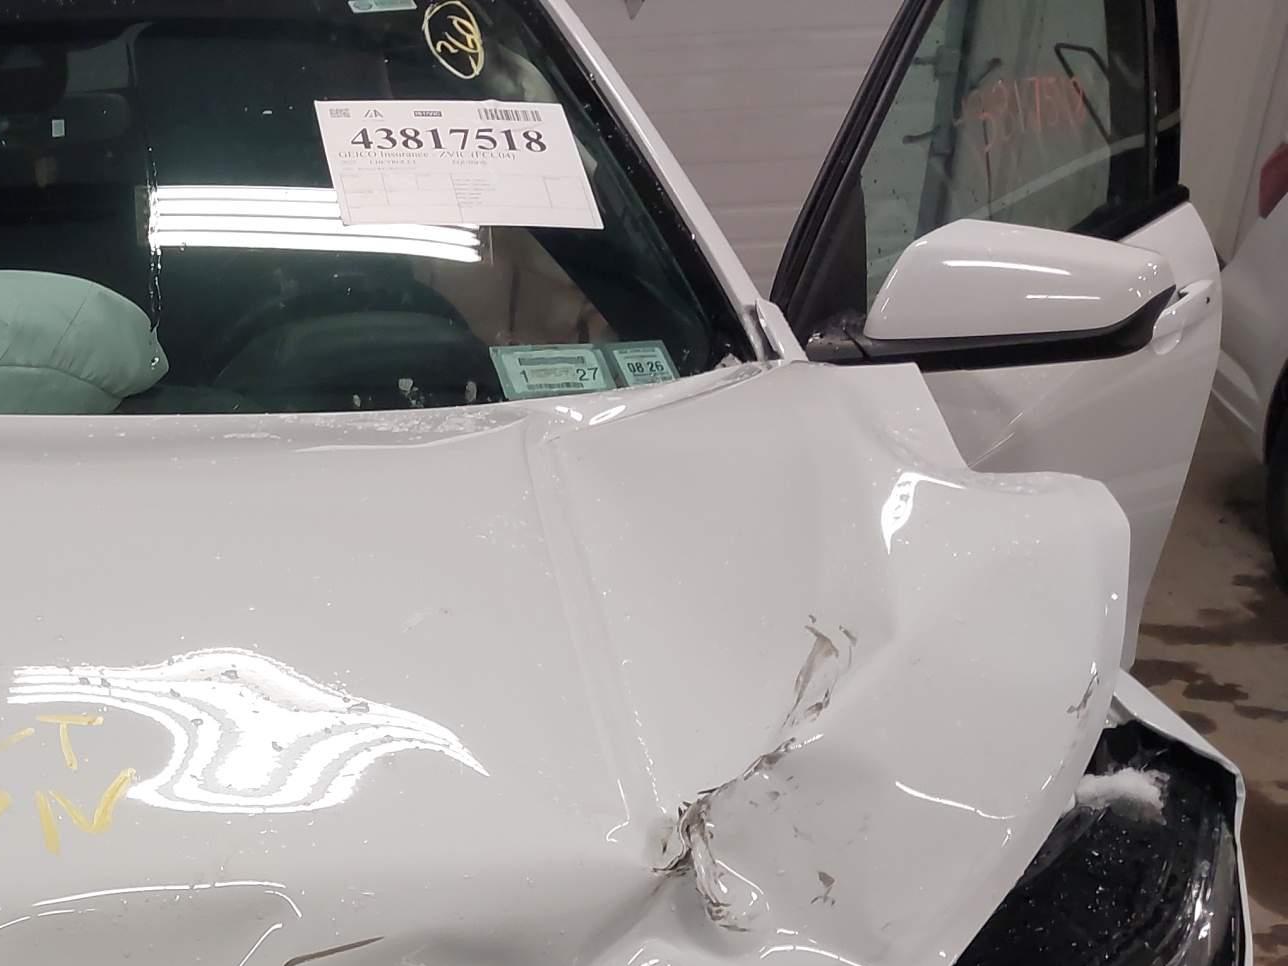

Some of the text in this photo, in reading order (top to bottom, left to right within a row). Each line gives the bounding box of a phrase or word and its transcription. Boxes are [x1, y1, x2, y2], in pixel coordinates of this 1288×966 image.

[350, 127, 547, 153] 43817518
[380, 151, 428, 159] Insurance
[626, 361, 665, 373] 08 26
[575, 367, 599, 381] 27
